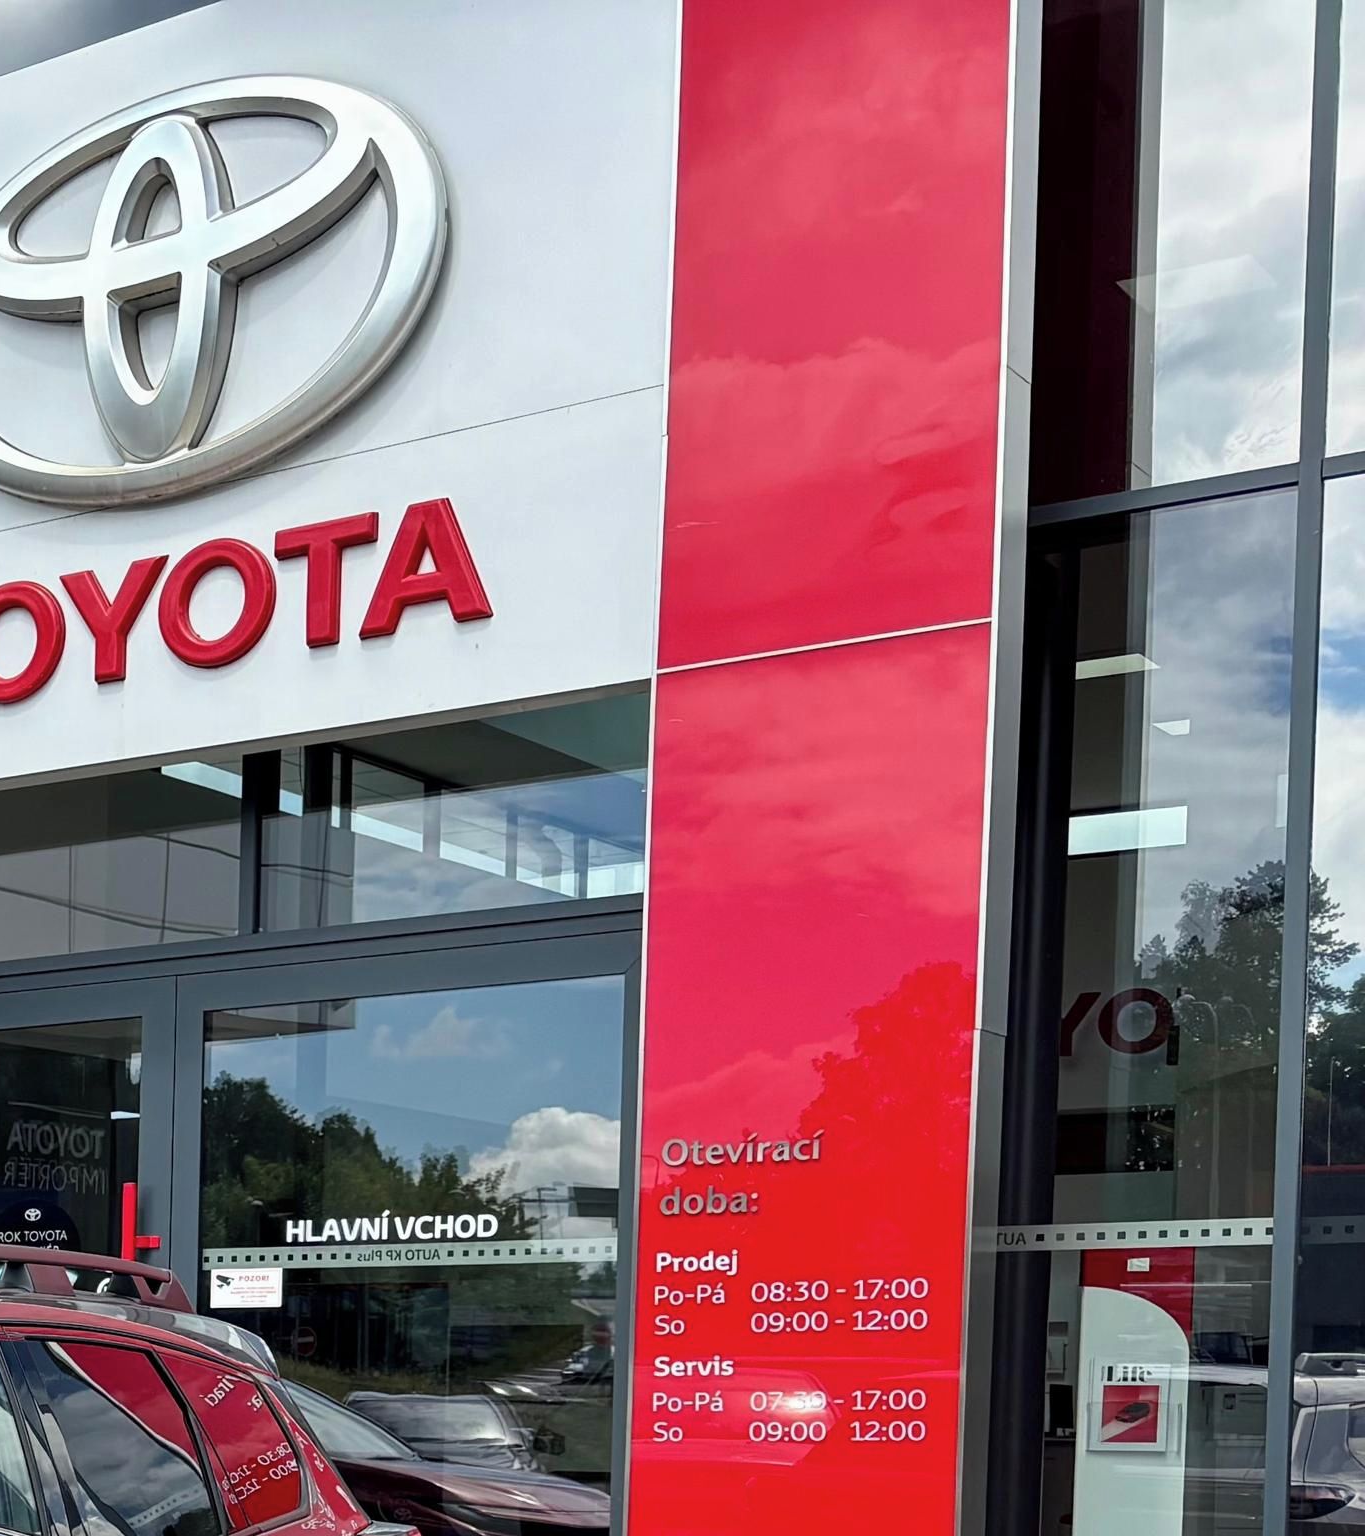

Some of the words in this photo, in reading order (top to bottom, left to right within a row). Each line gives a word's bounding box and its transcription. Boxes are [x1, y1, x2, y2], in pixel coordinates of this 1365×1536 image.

[662, 1129, 825, 1167] Otevírací
[659, 1185, 759, 1216] doba:
[23, 1230, 68, 1242] TOYOTA
[285, 1209, 391, 1243] HLAVNÍ
[393, 1214, 499, 1240] VCHOD
[655, 1249, 739, 1276] Prodej
[653, 1283, 726, 1306] Po-Pá
[751, 1280, 829, 1303] 08:30
[853, 1277, 929, 1300] 17:00
[654, 1315, 685, 1335] So
[750, 1311, 829, 1333] 09:00
[852, 1308, 928, 1331] 12:00
[653, 1355, 734, 1377] Servis
[652, 1390, 724, 1413] Po-Pá
[851, 1389, 927, 1411] 17:00
[653, 1421, 683, 1442] So
[749, 1421, 827, 1442] 09:00
[850, 1420, 926, 1442] 12:00
